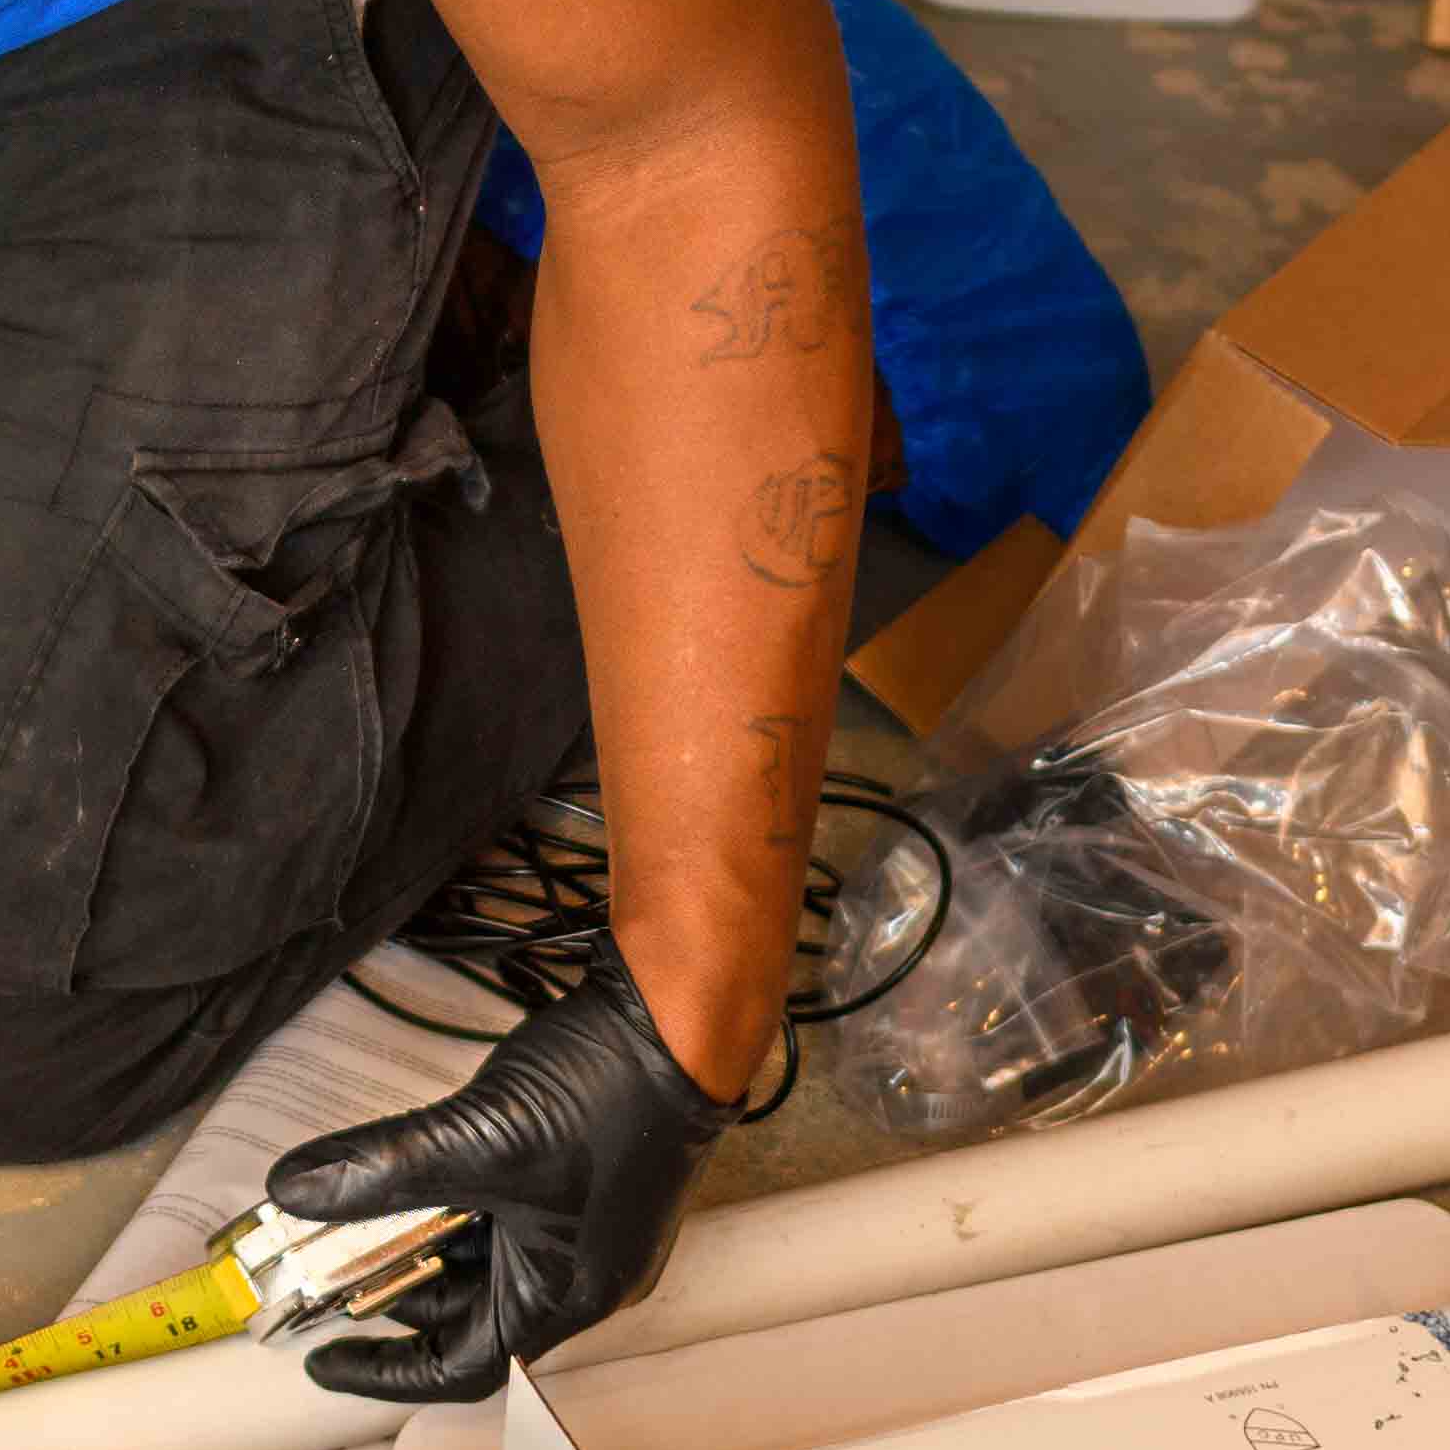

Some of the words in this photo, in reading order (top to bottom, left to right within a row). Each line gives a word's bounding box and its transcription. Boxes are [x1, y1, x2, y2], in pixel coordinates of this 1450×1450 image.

[77, 1329, 92, 1346] 5
[151, 1301, 165, 1319] 6
[167, 1315, 198, 1338] 18
